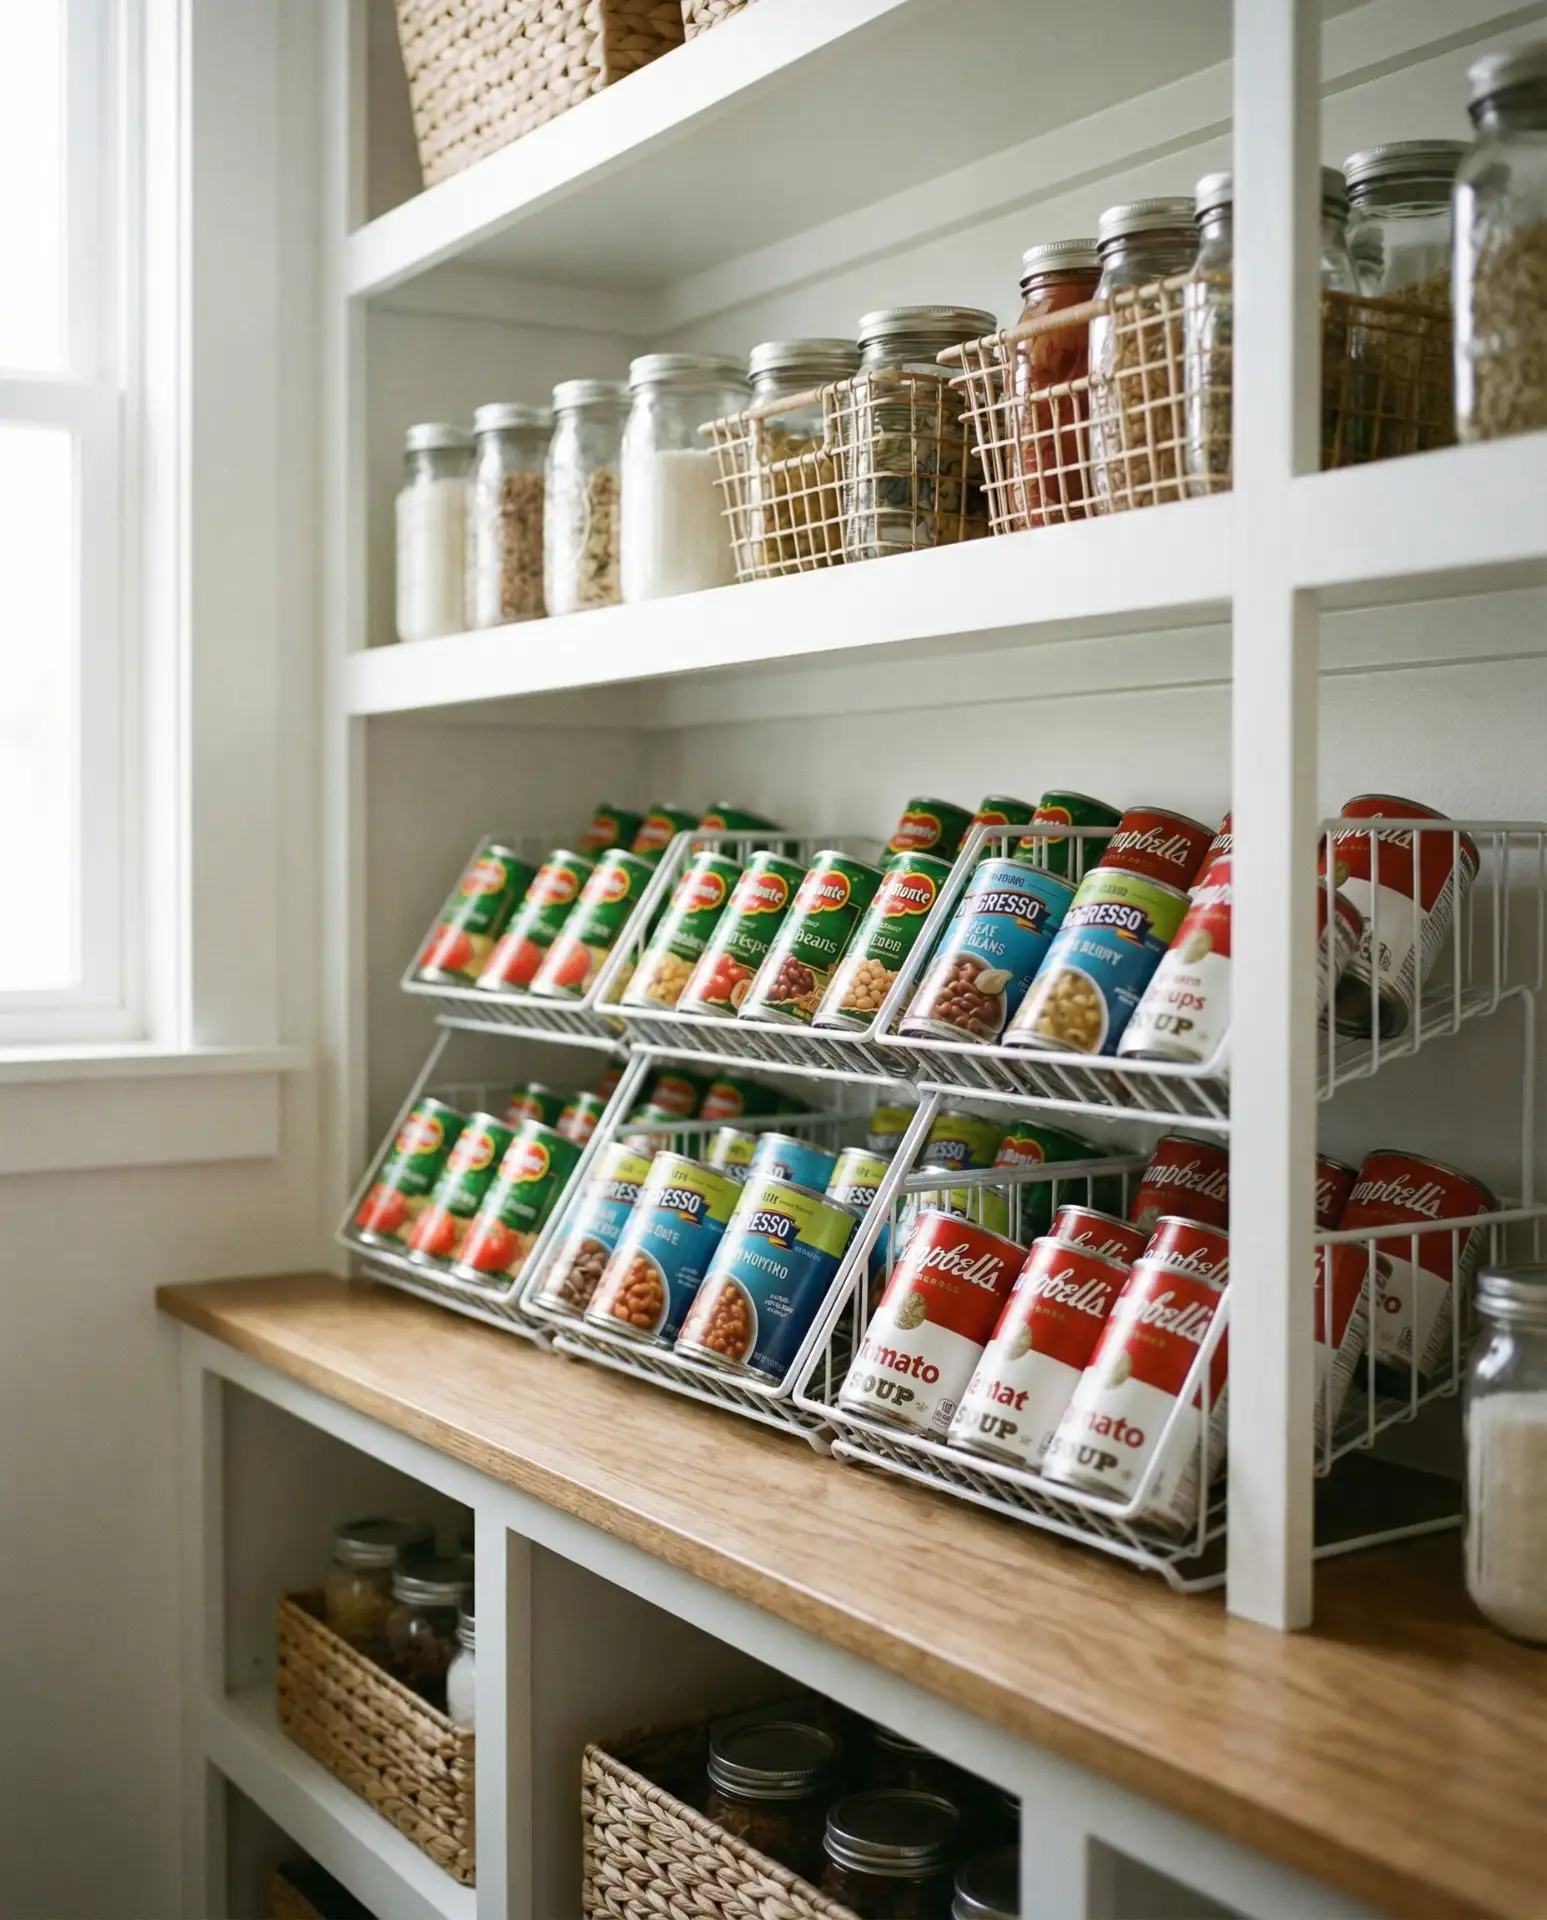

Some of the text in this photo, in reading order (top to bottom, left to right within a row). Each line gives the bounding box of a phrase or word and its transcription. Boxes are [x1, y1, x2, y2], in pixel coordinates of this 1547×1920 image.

[1350, 1168, 1446, 1219] mpbell's
[860, 1338, 940, 1385] Tmato
[850, 1372, 915, 1406] SOUP
[955, 1406, 1018, 1440] SUP
